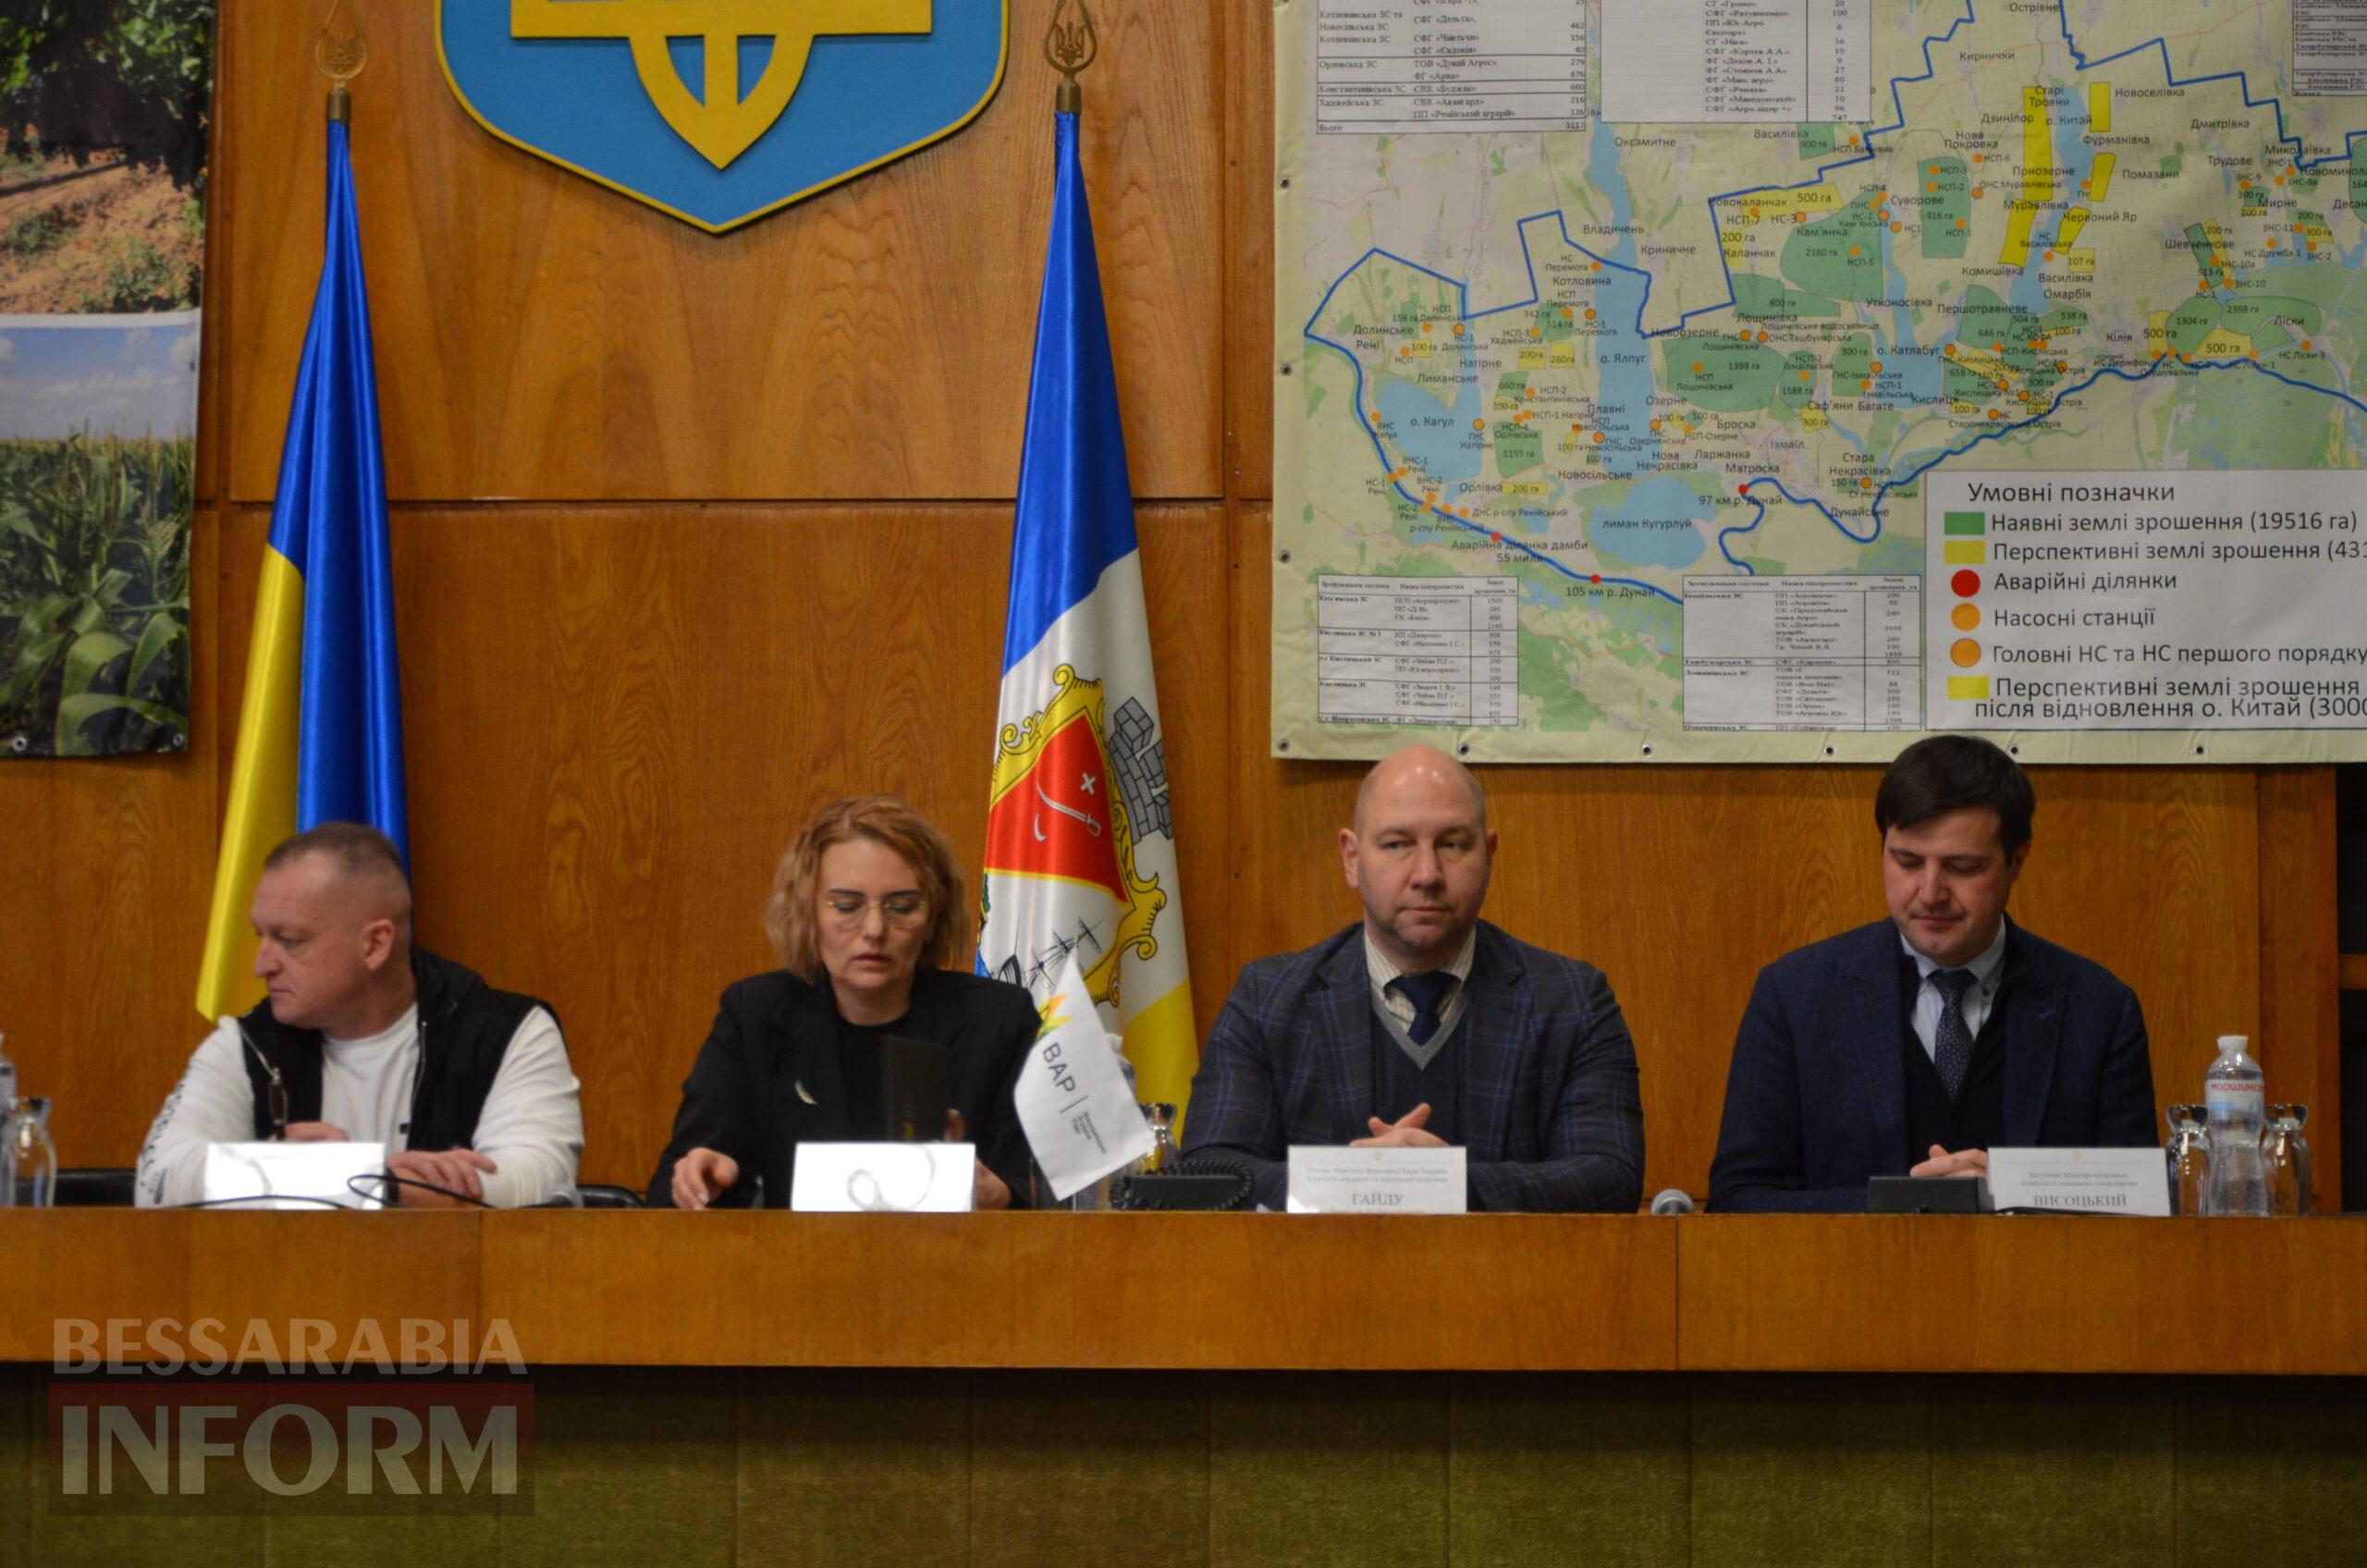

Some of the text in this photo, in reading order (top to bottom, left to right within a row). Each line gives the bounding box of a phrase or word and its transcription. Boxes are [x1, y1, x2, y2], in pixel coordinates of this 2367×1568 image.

[2010, 4, 2059, 14] Острівне
[1960, 52, 2015, 62] Кирнички
[2035, 86, 2064, 96] Старі
[2116, 88, 2185, 97] Новоселівка
[2030, 97, 2069, 107] Трояни
[1981, 115, 2034, 125] Дзинілор
[2060, 115, 2092, 125] Китай
[2190, 119, 2250, 129] Дмитрівка
[1755, 129, 1809, 139] Василівка
[1956, 131, 1983, 140] Нова
[1614, 138, 1675, 147] Оксамитне
[1944, 141, 1998, 150] Покровка
[2083, 136, 2150, 146] Фурманівка
[2207, 155, 2252, 166] Трудове
[2013, 166, 2075, 177] Приозерне
[1798, 193, 1817, 202] 500
[1891, 196, 1944, 205] Суворове
[2005, 202, 2068, 211] Муравлівка
[2259, 199, 2298, 208] Мирне
[2064, 213, 2137, 223] Червоний Яр
[1584, 226, 1644, 236] Владичень
[1723, 233, 1741, 242] 200
[1641, 246, 1696, 254] Криничне
[2165, 240, 2234, 250] Шевченкове
[1723, 249, 1775, 257] Каланчак
[1962, 267, 2024, 276] Комишівка
[1553, 277, 1612, 287] Котловина
[2039, 274, 2093, 283] Василівка
[1866, 298, 1932, 308] Утконосівка
[1938, 304, 2028, 314] Першотравневе
[1737, 313, 1797, 323] Лощинівка
[2275, 316, 2304, 325] Ліски
[1354, 325, 1414, 336] Долинське
[2143, 329, 2163, 338] 500
[2106, 333, 2133, 343] Кілія
[1357, 340, 1380, 350] Рені
[2207, 344, 2226, 352] 500
[1892, 347, 1939, 356] Катлабуг
[1615, 354, 1645, 364] Ялпуг
[1460, 360, 1502, 370] Нагірне
[1417, 374, 1478, 384] Лиманське
[1646, 397, 1686, 406] Озерне
[1858, 401, 1894, 411] Багате
[1588, 405, 1625, 415] Плавні
[1425, 418, 1453, 428] Кагул
[1718, 421, 1755, 430] Броска
[1771, 440, 1805, 448] Ізмаїл
[1652, 452, 1679, 460] Нова
[1695, 450, 1750, 460] Ларжанка
[1843, 453, 1874, 463] Стара
[1637, 461, 1698, 472] Некрасівка
[1725, 464, 1780, 473] Матроска
[1830, 467, 1891, 476] Некрасівка
[1558, 472, 1632, 481] Новосільське
[1461, 484, 1502, 493] Орлівка
[1968, 483, 2175, 503] Умовні позначки
[1699, 496, 1711, 504] 97
[1603, 520, 1692, 530] лиман Кугурлуй
[1991, 510, 2358, 533] Наявні землі зрошення (19516 га)
[1453, 540, 1502, 550] Аварійна
[1551, 541, 1588, 551] дамби
[1497, 554, 1509, 562] 55
[1994, 543, 2139, 563] Перспективні
[2145, 543, 2205, 559] землі
[2212, 544, 2320, 562] зрошення
[1994, 572, 2177, 594] Аварійні ділянки
[1567, 588, 1585, 596] 105
[1621, 588, 1655, 598] Дунай
[1994, 608, 2155, 630] Насосні станції
[1993, 645, 2367, 667] Головні НС та НС першого порядку
[1996, 678, 2360, 699] Перспективні землі зрошення
[1976, 700, 2035, 717] після
[2042, 699, 2193, 719] відновлення
[2201, 703, 2222, 717] о.
[2231, 697, 2300, 717] Китай
[1353, 1192, 1404, 1206] ГАЙДУ
[2034, 1194, 2127, 1207] ВИСОЦЬКИЙ
